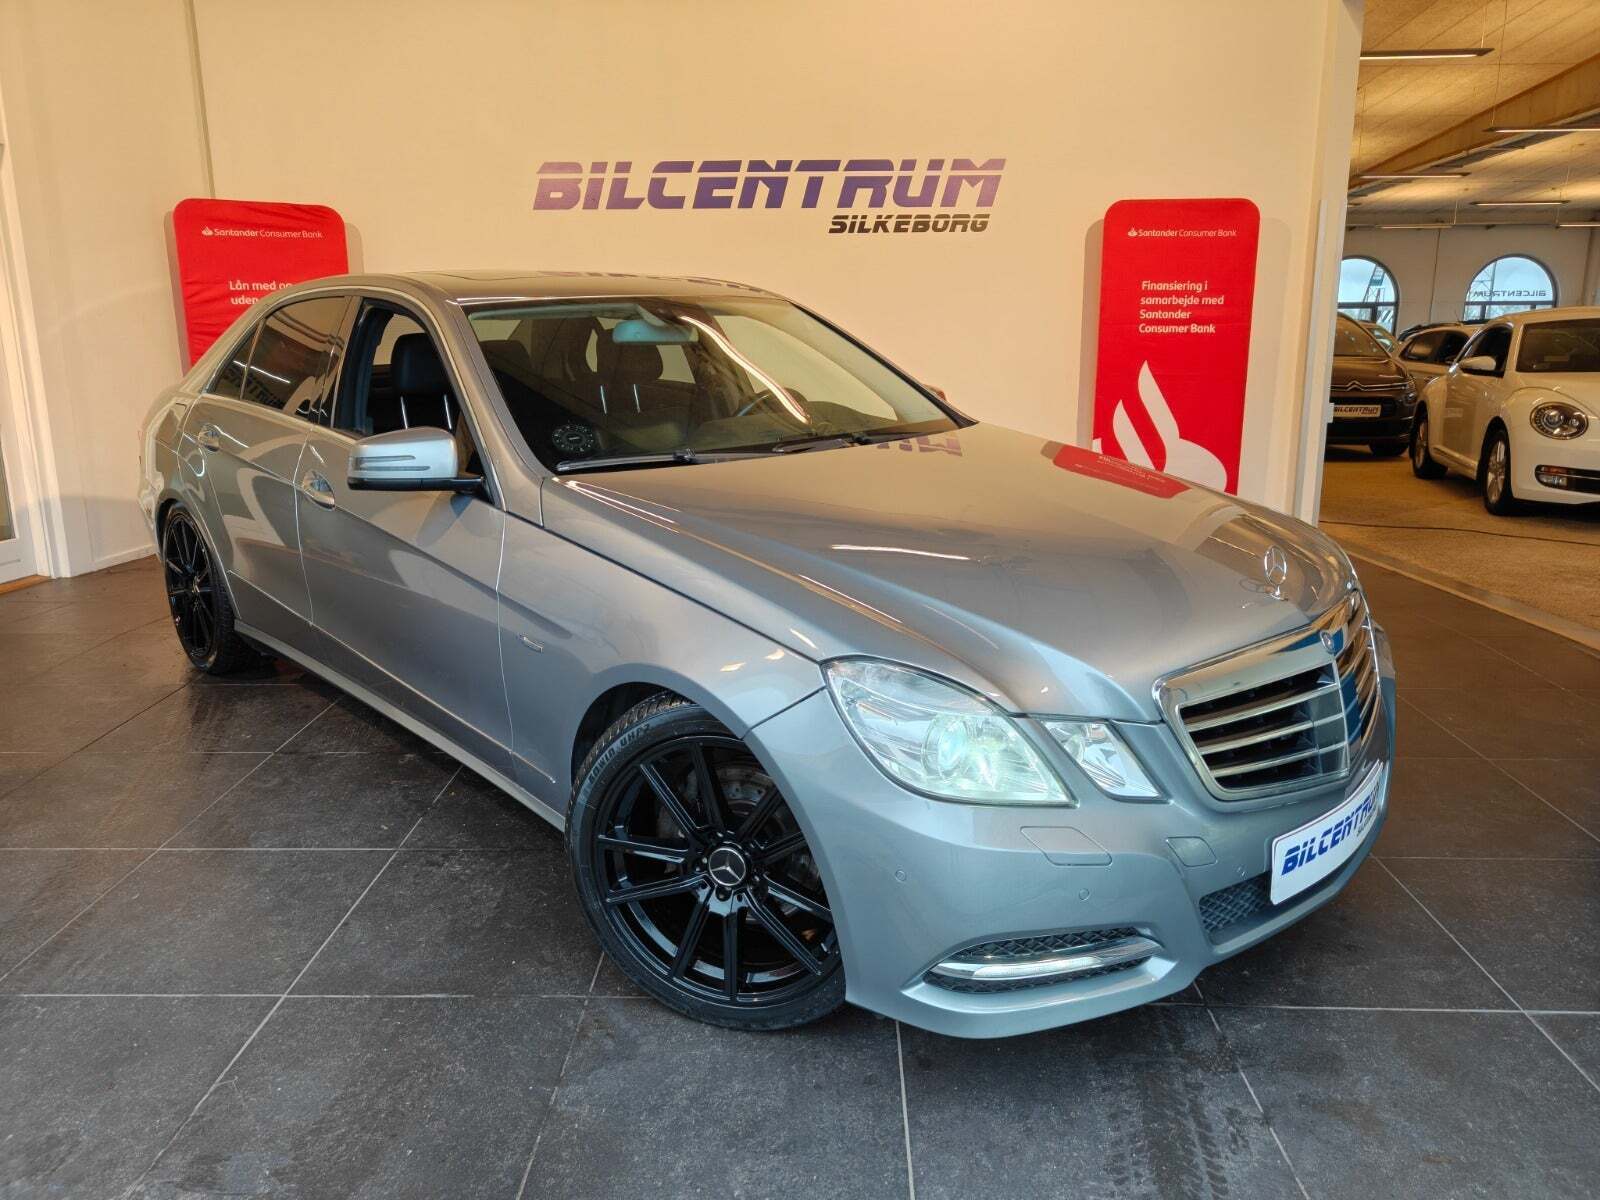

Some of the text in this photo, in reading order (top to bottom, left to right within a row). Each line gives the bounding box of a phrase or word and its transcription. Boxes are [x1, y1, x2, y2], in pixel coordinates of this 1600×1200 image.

[532, 158, 1006, 211] BILCENTRUM
[828, 213, 990, 234] SILKEBORG
[215, 228, 322, 239] Santander Consumer Bank
[1139, 228, 1237, 237] Santander Consumer Bank
[229, 280, 250, 291] Lån
[252, 280, 276, 291] med
[1141, 280, 1208, 293] Finansiering i
[1140, 294, 1225, 307] samarbejde med
[1139, 309, 1192, 319] Santander
[1138, 324, 1216, 334] Consumer Bank
